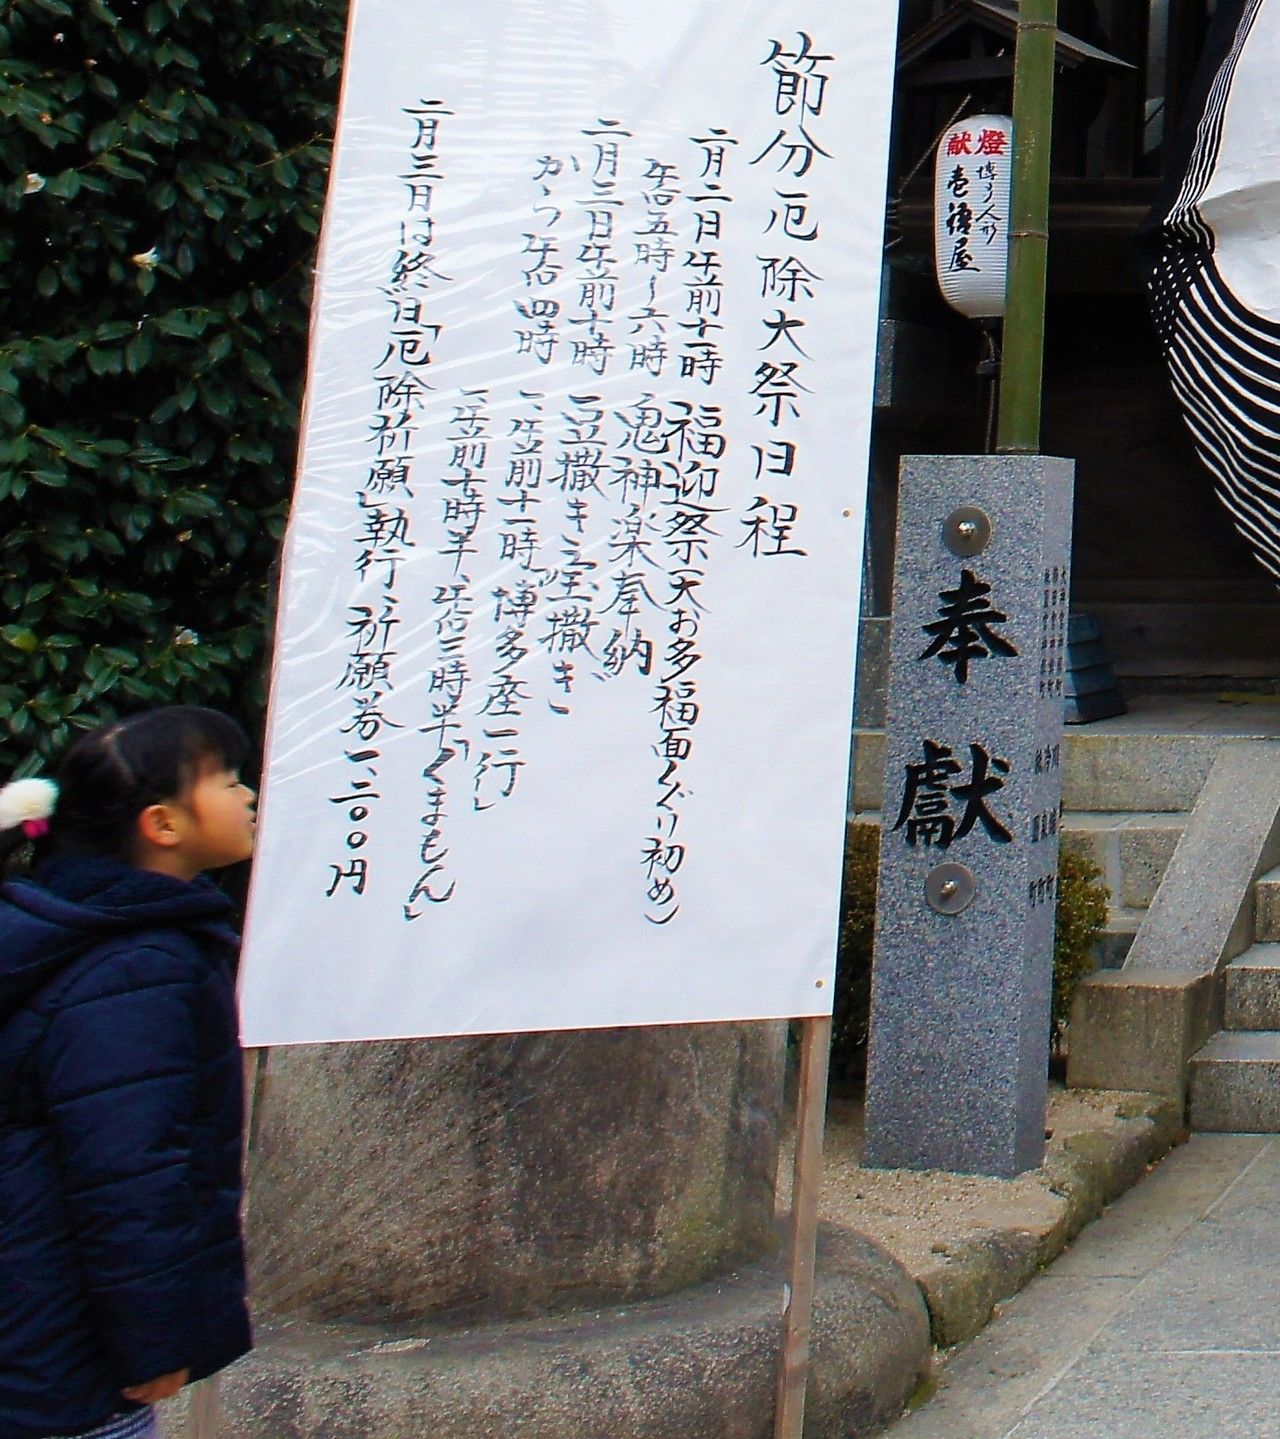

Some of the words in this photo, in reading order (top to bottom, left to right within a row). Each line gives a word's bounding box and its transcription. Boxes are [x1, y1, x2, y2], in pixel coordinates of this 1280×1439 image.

[678, 127, 739, 386] 二月二日午前十一時
[735, 31, 836, 559] 節分厄除大祭日程
